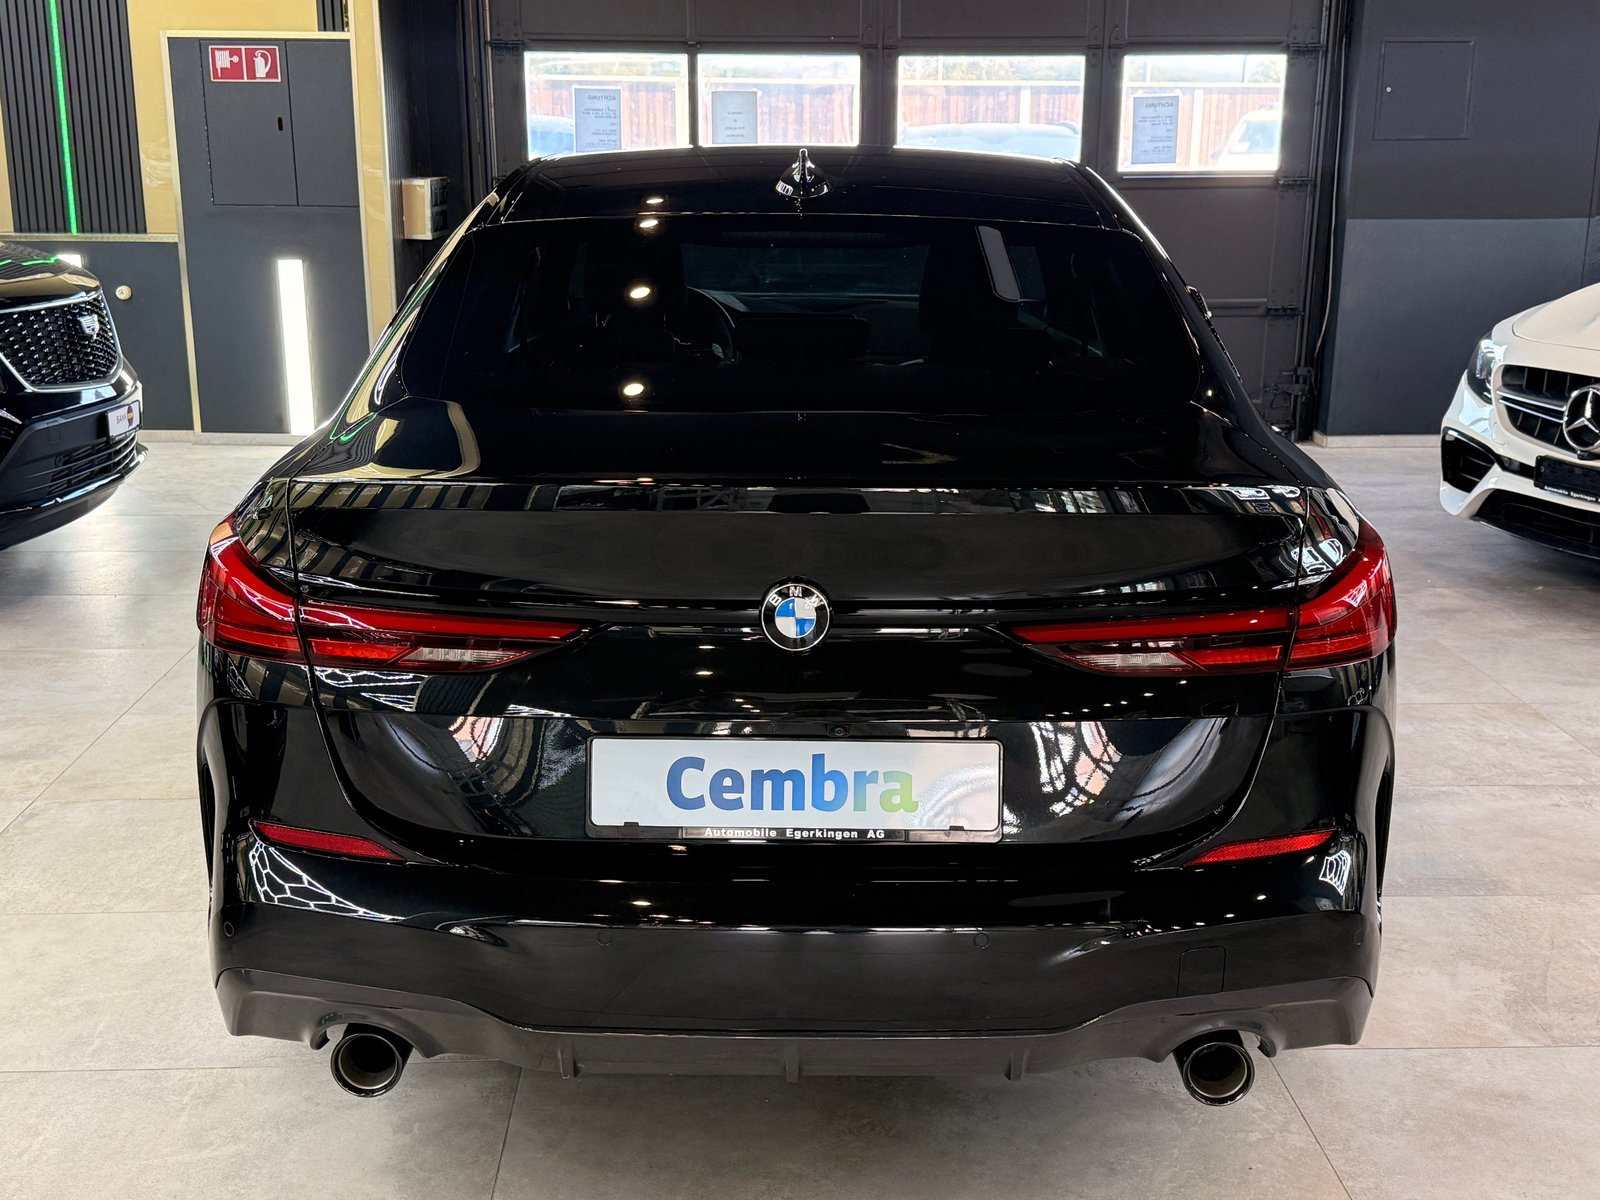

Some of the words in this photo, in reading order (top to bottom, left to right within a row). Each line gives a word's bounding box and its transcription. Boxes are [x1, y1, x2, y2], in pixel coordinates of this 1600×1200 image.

[769, 586, 825, 608] BMW
[666, 753, 919, 813] Cembra
[704, 827, 777, 838] Automobile
[785, 829, 858, 840] Egerkingen
[866, 829, 886, 839] AG
